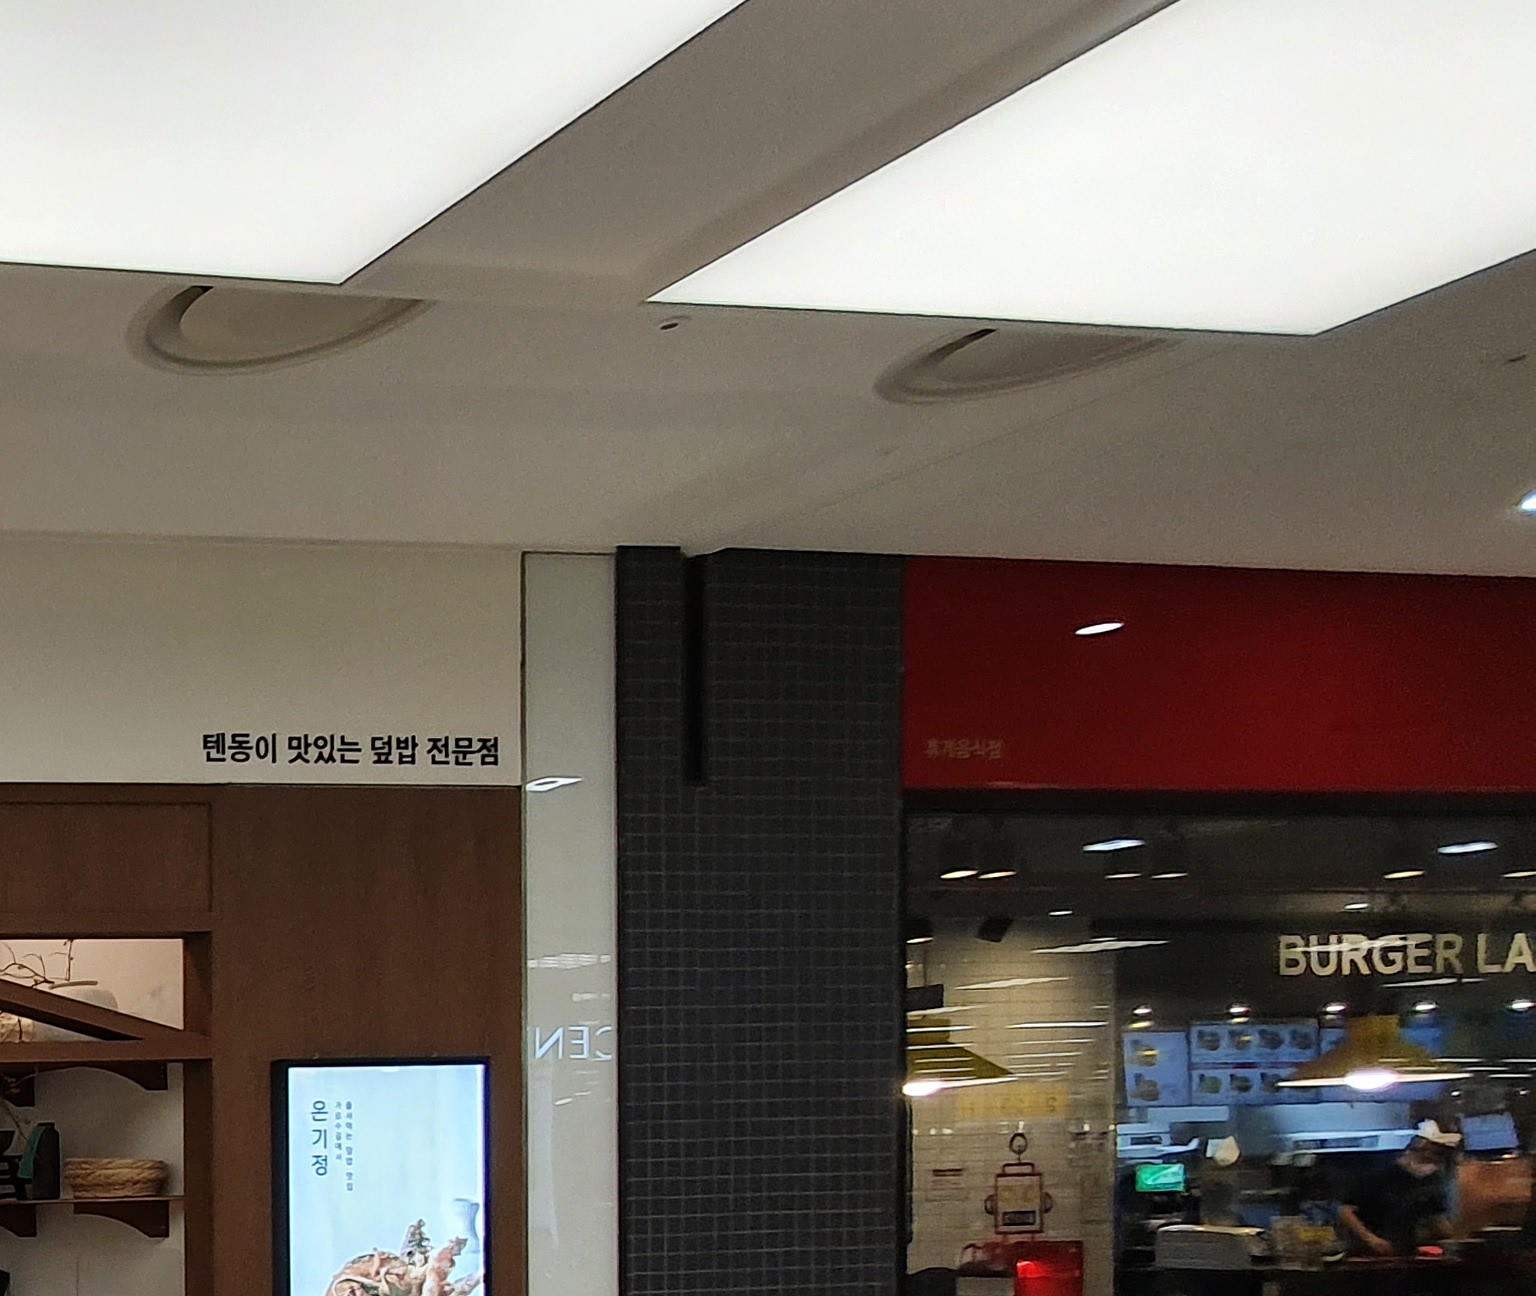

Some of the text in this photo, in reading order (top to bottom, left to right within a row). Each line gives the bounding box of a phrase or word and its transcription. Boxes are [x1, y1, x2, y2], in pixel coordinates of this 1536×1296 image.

[203, 732, 499, 766] 텐동이 맛있는 덮밥 전문점
[1279, 933, 1464, 976] BURGER
[310, 1100, 329, 1176] 온기정
